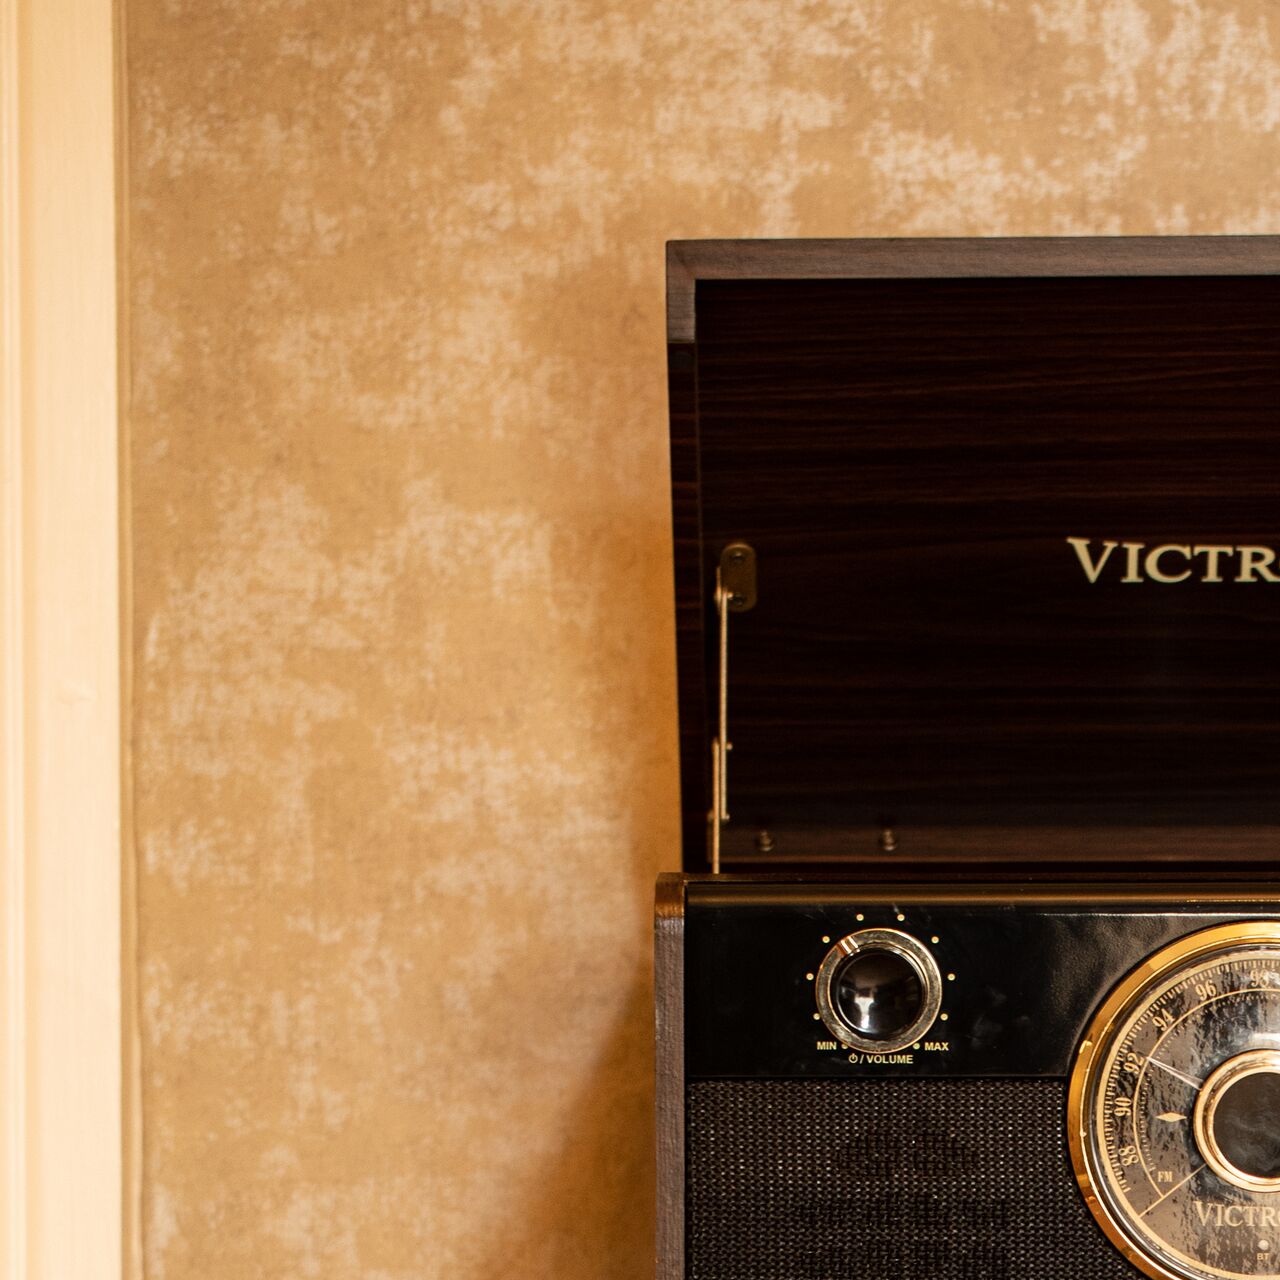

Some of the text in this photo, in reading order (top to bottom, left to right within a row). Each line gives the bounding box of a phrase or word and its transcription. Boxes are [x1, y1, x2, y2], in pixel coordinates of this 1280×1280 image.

[1195, 979, 1217, 1001] 96
[1152, 1010, 1176, 1031] 94
[816, 1041, 837, 1051] MIN
[924, 1041, 949, 1051] MAX
[866, 1054, 914, 1065] VOLUME
[1123, 1052, 1145, 1075] 92
[1114, 1097, 1132, 1118] 90
[1118, 1145, 1139, 1167] 88
[1157, 1171, 1173, 1183] FM
[1256, 1252, 1270, 1261] BT
